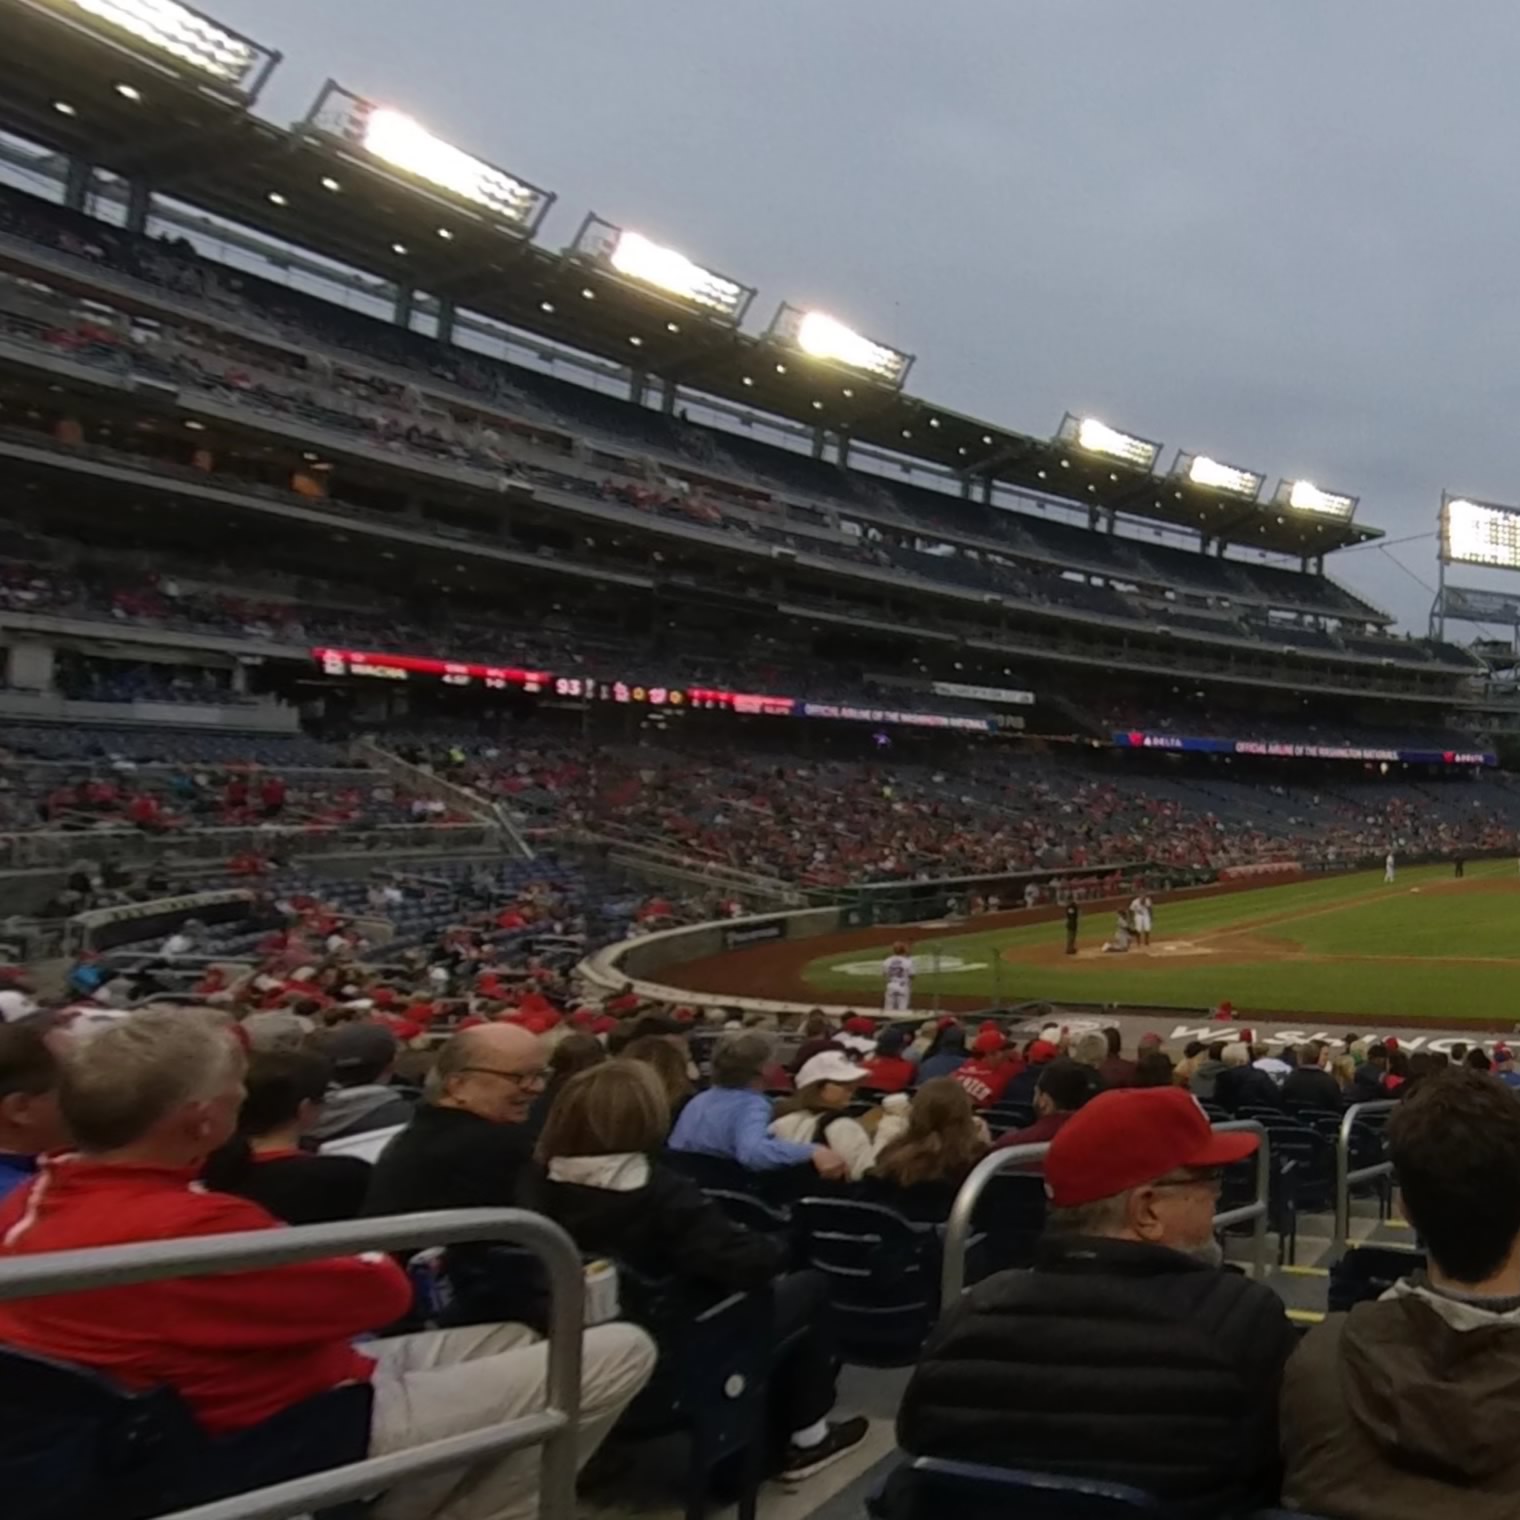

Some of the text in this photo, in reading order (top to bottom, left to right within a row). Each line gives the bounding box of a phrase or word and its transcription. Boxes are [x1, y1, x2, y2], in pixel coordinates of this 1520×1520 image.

[556, 678, 582, 696] 93
[804, 702, 839, 718] OFFICIAL
[841, 705, 870, 720] AIRLINE
[871, 708, 883, 722] OF
[885, 710, 900, 723] THE
[900, 711, 949, 727] WASHINGTON
[1153, 737, 1183, 748] DELTA
[1235, 740, 1267, 755] OFFICIAL
[1268, 742, 1293, 757] AIRLINE
[1294, 745, 1304, 757] OF
[1305, 745, 1318, 757] THE
[1318, 746, 1362, 760] WASHINGTON
